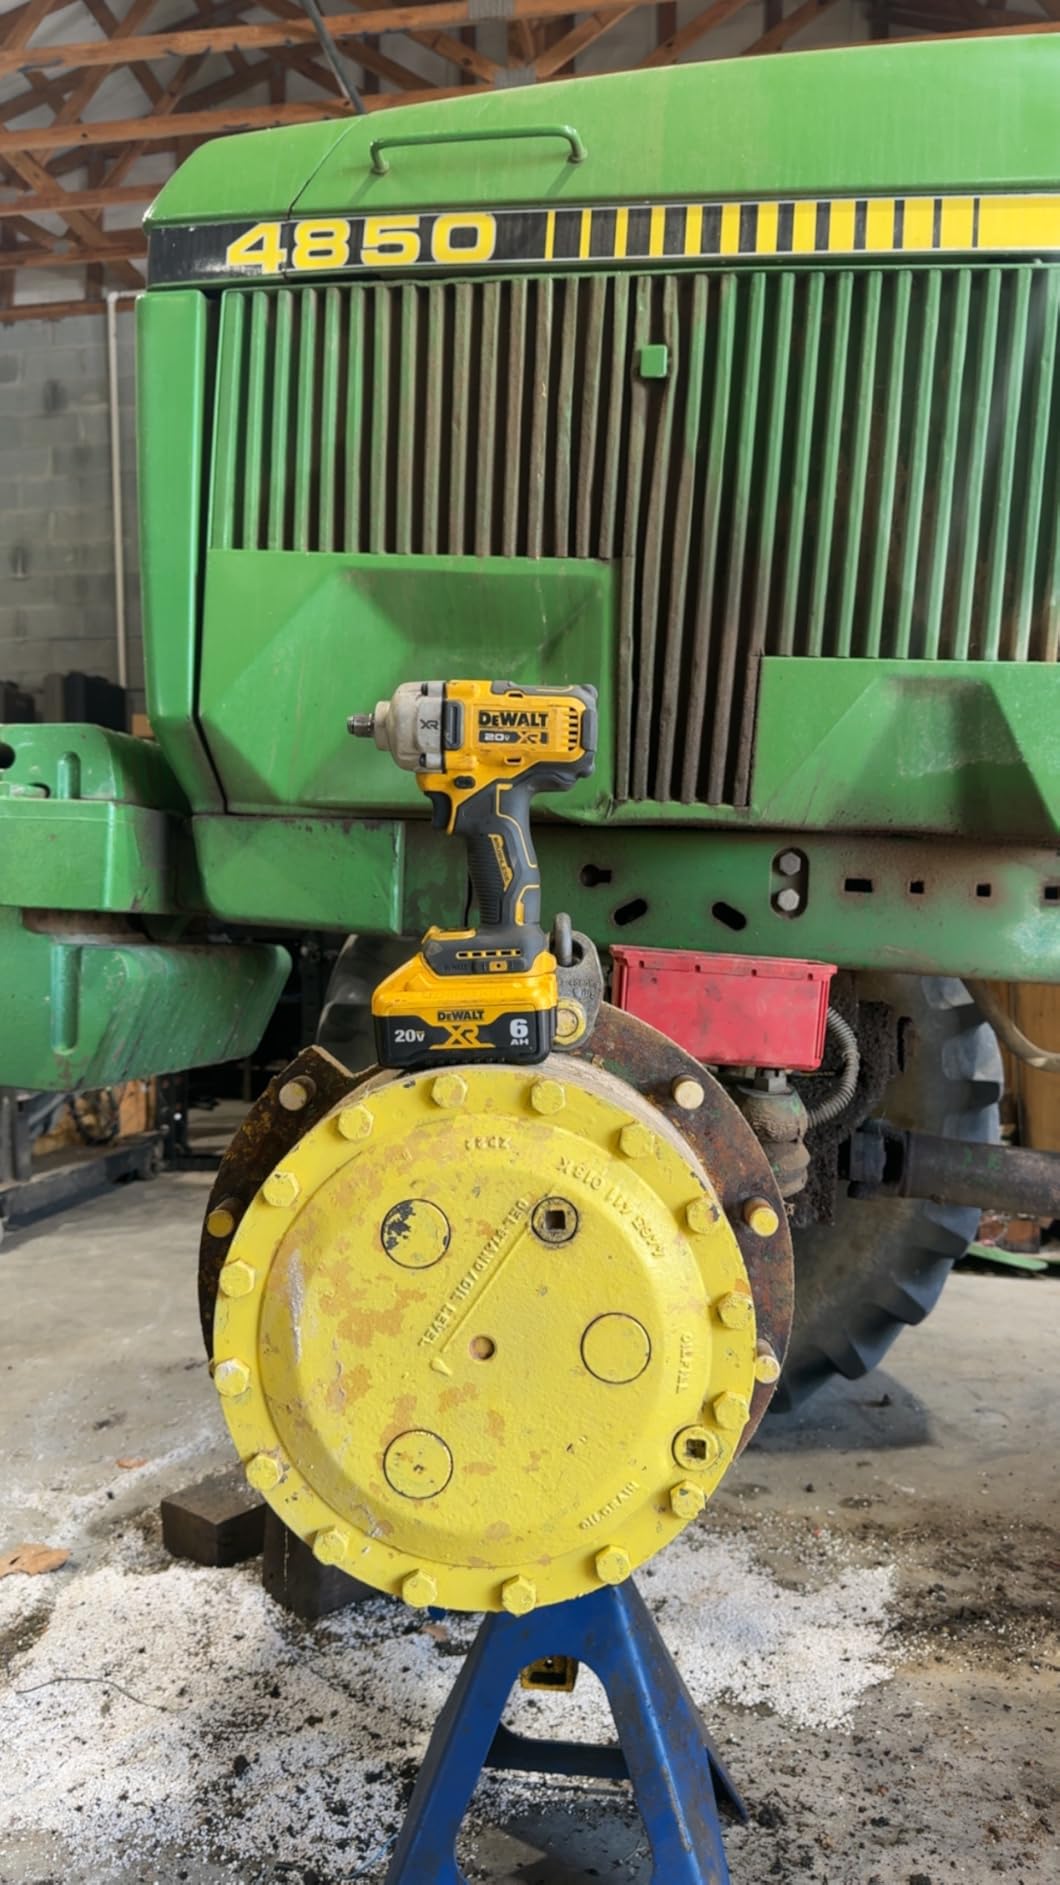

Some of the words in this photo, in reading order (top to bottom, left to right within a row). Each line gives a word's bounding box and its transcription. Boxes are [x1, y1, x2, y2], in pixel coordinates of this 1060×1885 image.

[226, 213, 496, 274] 4850
[419, 719, 439, 730] XR
[509, 1018, 529, 1038] 6
